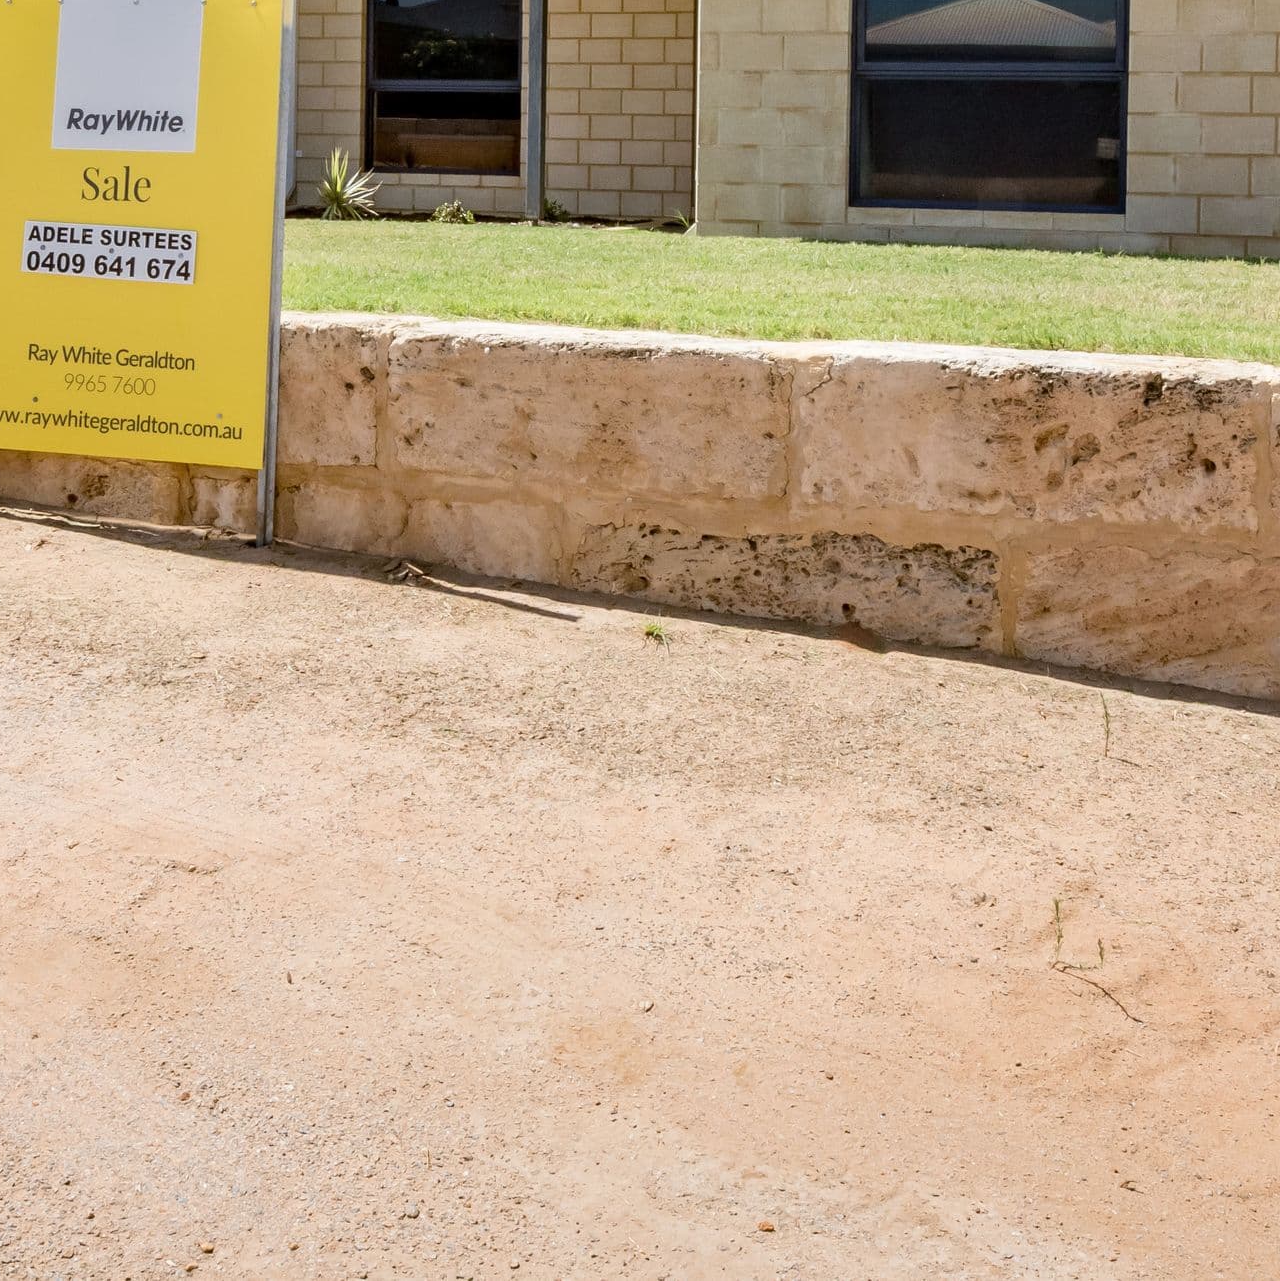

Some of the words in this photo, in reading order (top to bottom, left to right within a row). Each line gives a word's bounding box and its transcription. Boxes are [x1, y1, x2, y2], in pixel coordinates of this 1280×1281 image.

[81, 166, 151, 202] Sale
[28, 225, 93, 245] ADELE
[100, 229, 193, 251] SURTEES
[26, 251, 85, 274] 0409
[94, 255, 136, 277] 641
[147, 259, 190, 281] 674
[28, 344, 58, 365] Ray
[62, 345, 112, 367] White
[115, 349, 195, 370] Geraldton
[64, 373, 107, 393] 9965
[112, 376, 156, 396] 7600
